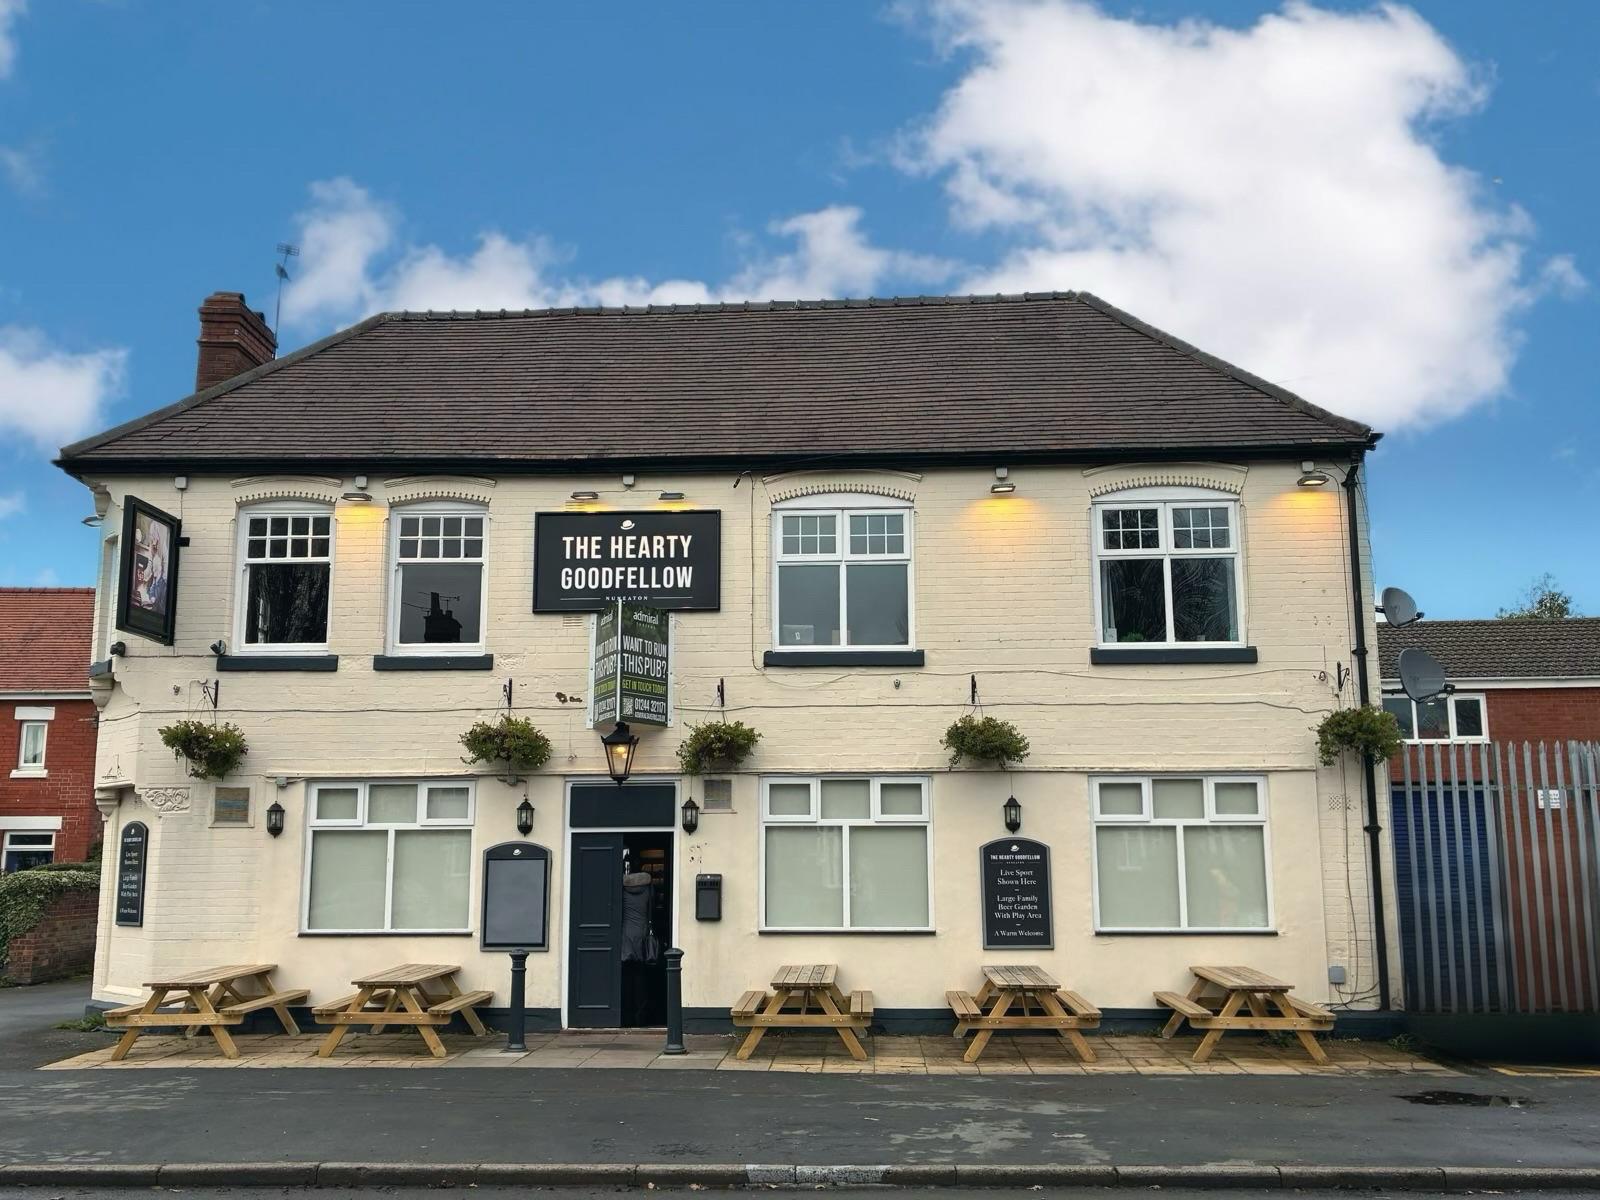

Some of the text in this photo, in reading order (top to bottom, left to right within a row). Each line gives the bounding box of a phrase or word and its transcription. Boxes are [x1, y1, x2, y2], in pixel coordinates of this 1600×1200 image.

[562, 535, 692, 560] THE HEARTY
[561, 566, 693, 590] GOODFELLOW
[633, 610, 658, 624] admiral
[622, 635, 667, 658] WANT TO RUN
[622, 653, 667, 678] THIS PUB?
[622, 679, 631, 689] GET
[635, 698, 650, 711] 01244
[997, 895, 1016, 903] Large
